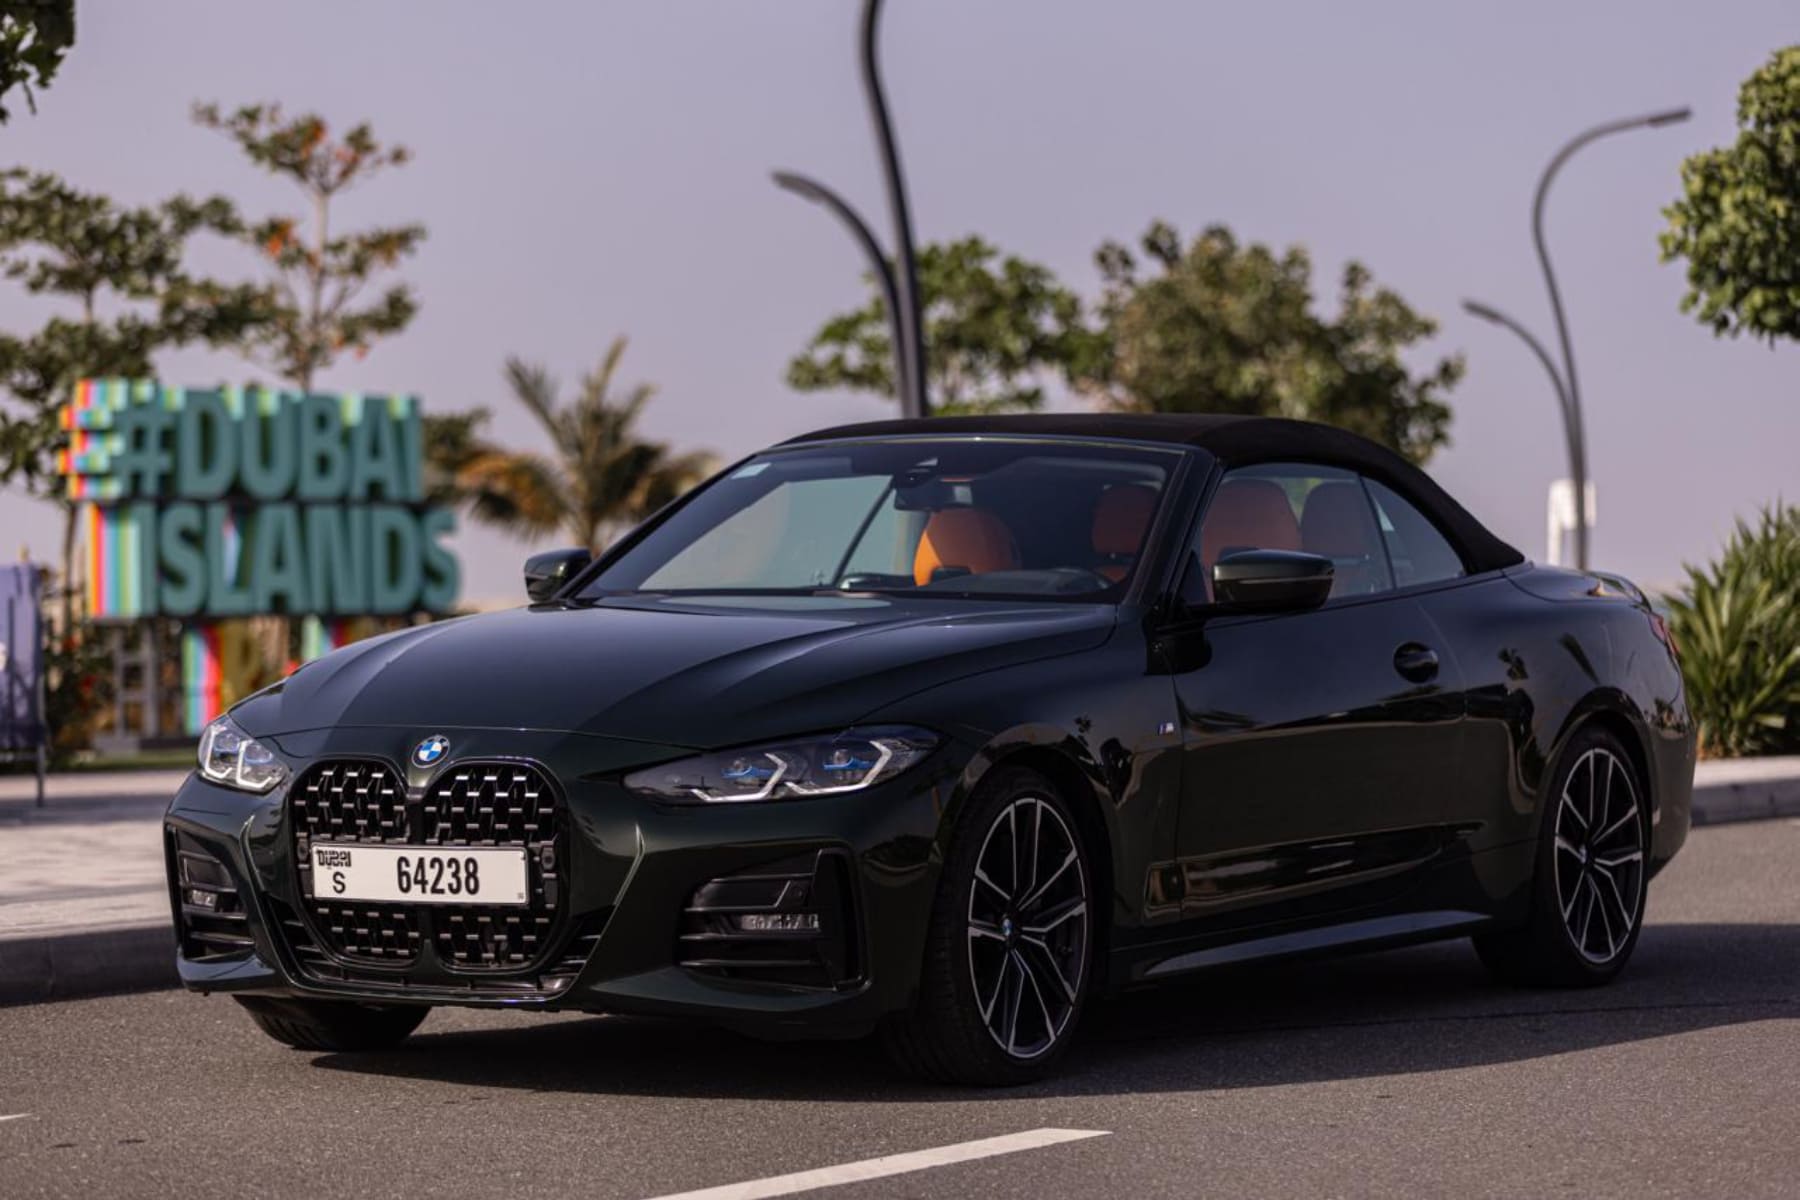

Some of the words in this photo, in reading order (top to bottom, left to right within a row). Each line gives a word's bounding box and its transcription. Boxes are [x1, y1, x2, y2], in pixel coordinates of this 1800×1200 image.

[108, 388, 424, 499] #DUBAI
[136, 503, 461, 615] ISLANDS
[332, 871, 346, 894] S
[396, 856, 480, 895] 64238
